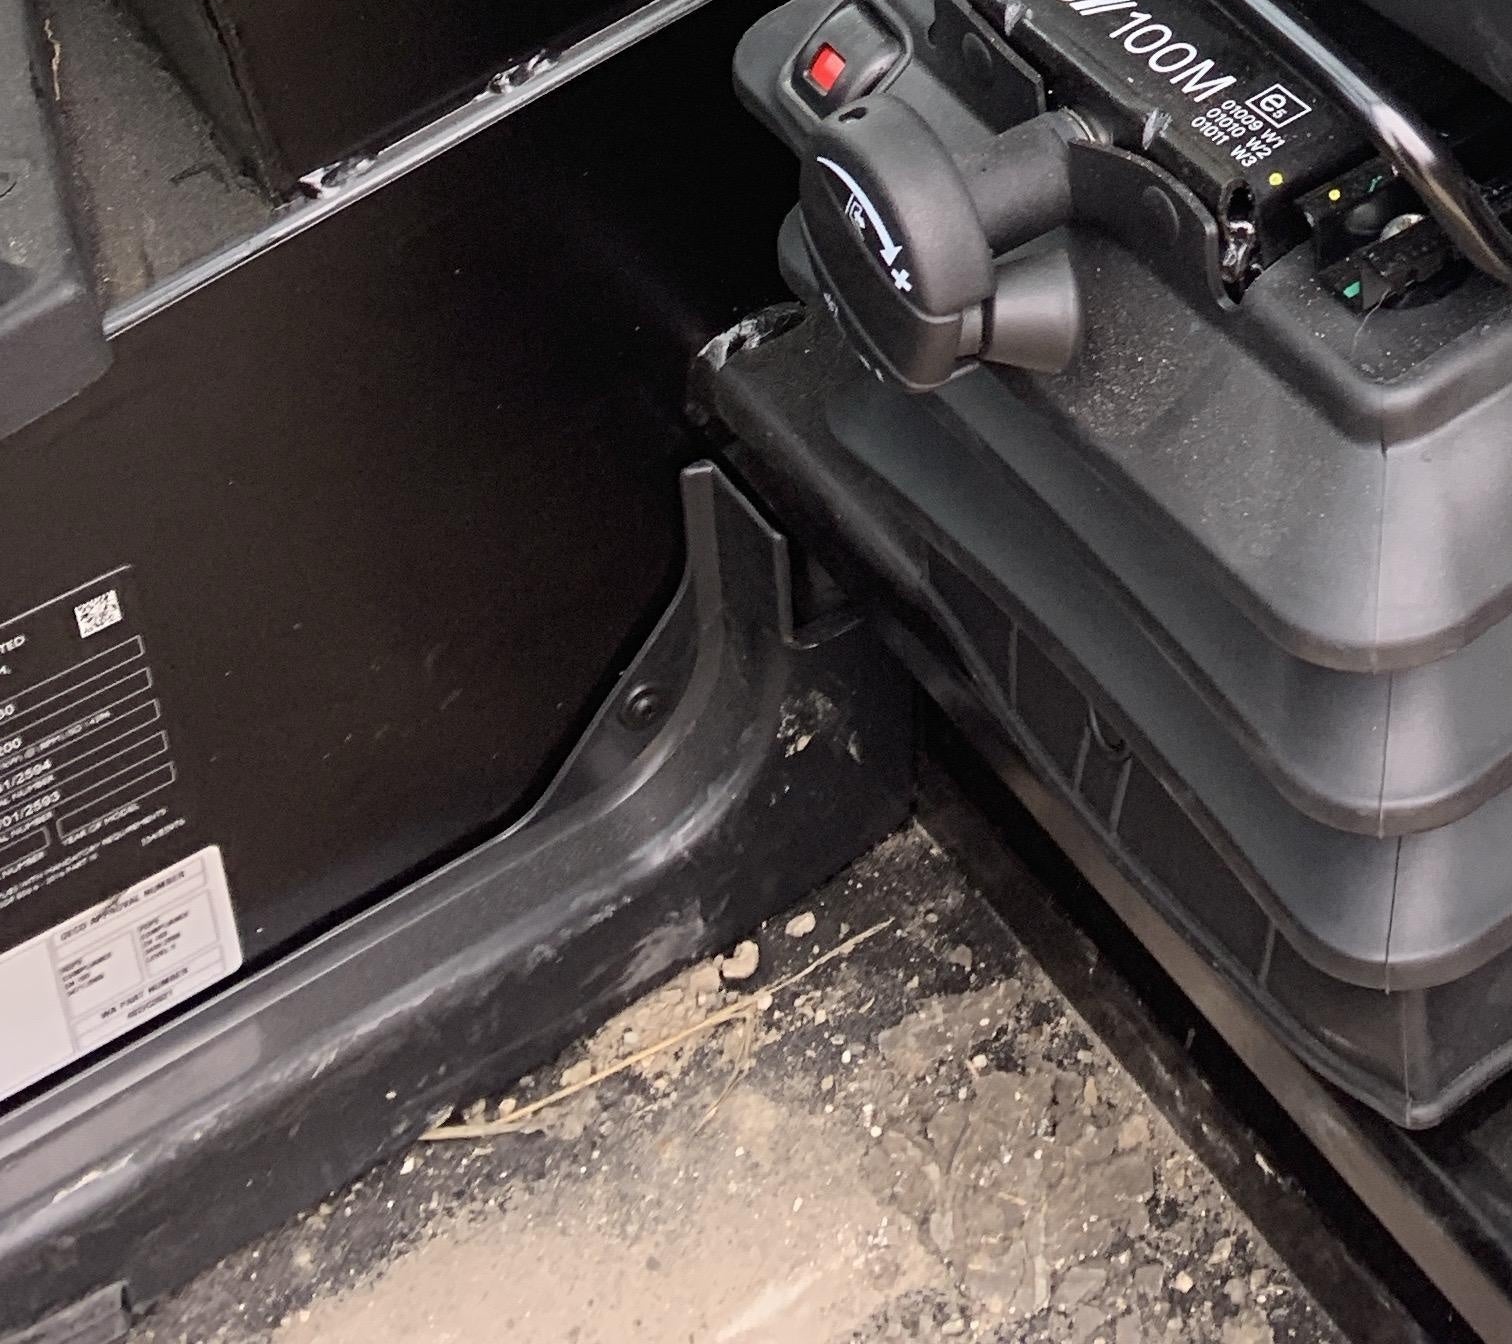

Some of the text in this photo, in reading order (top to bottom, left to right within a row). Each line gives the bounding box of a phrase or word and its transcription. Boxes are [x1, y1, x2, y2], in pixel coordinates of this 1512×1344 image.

[1191, 116, 1257, 167] 01011 W3
[1206, 107, 1272, 160] 01010 W2
[1221, 99, 1286, 149] 01009 W1
